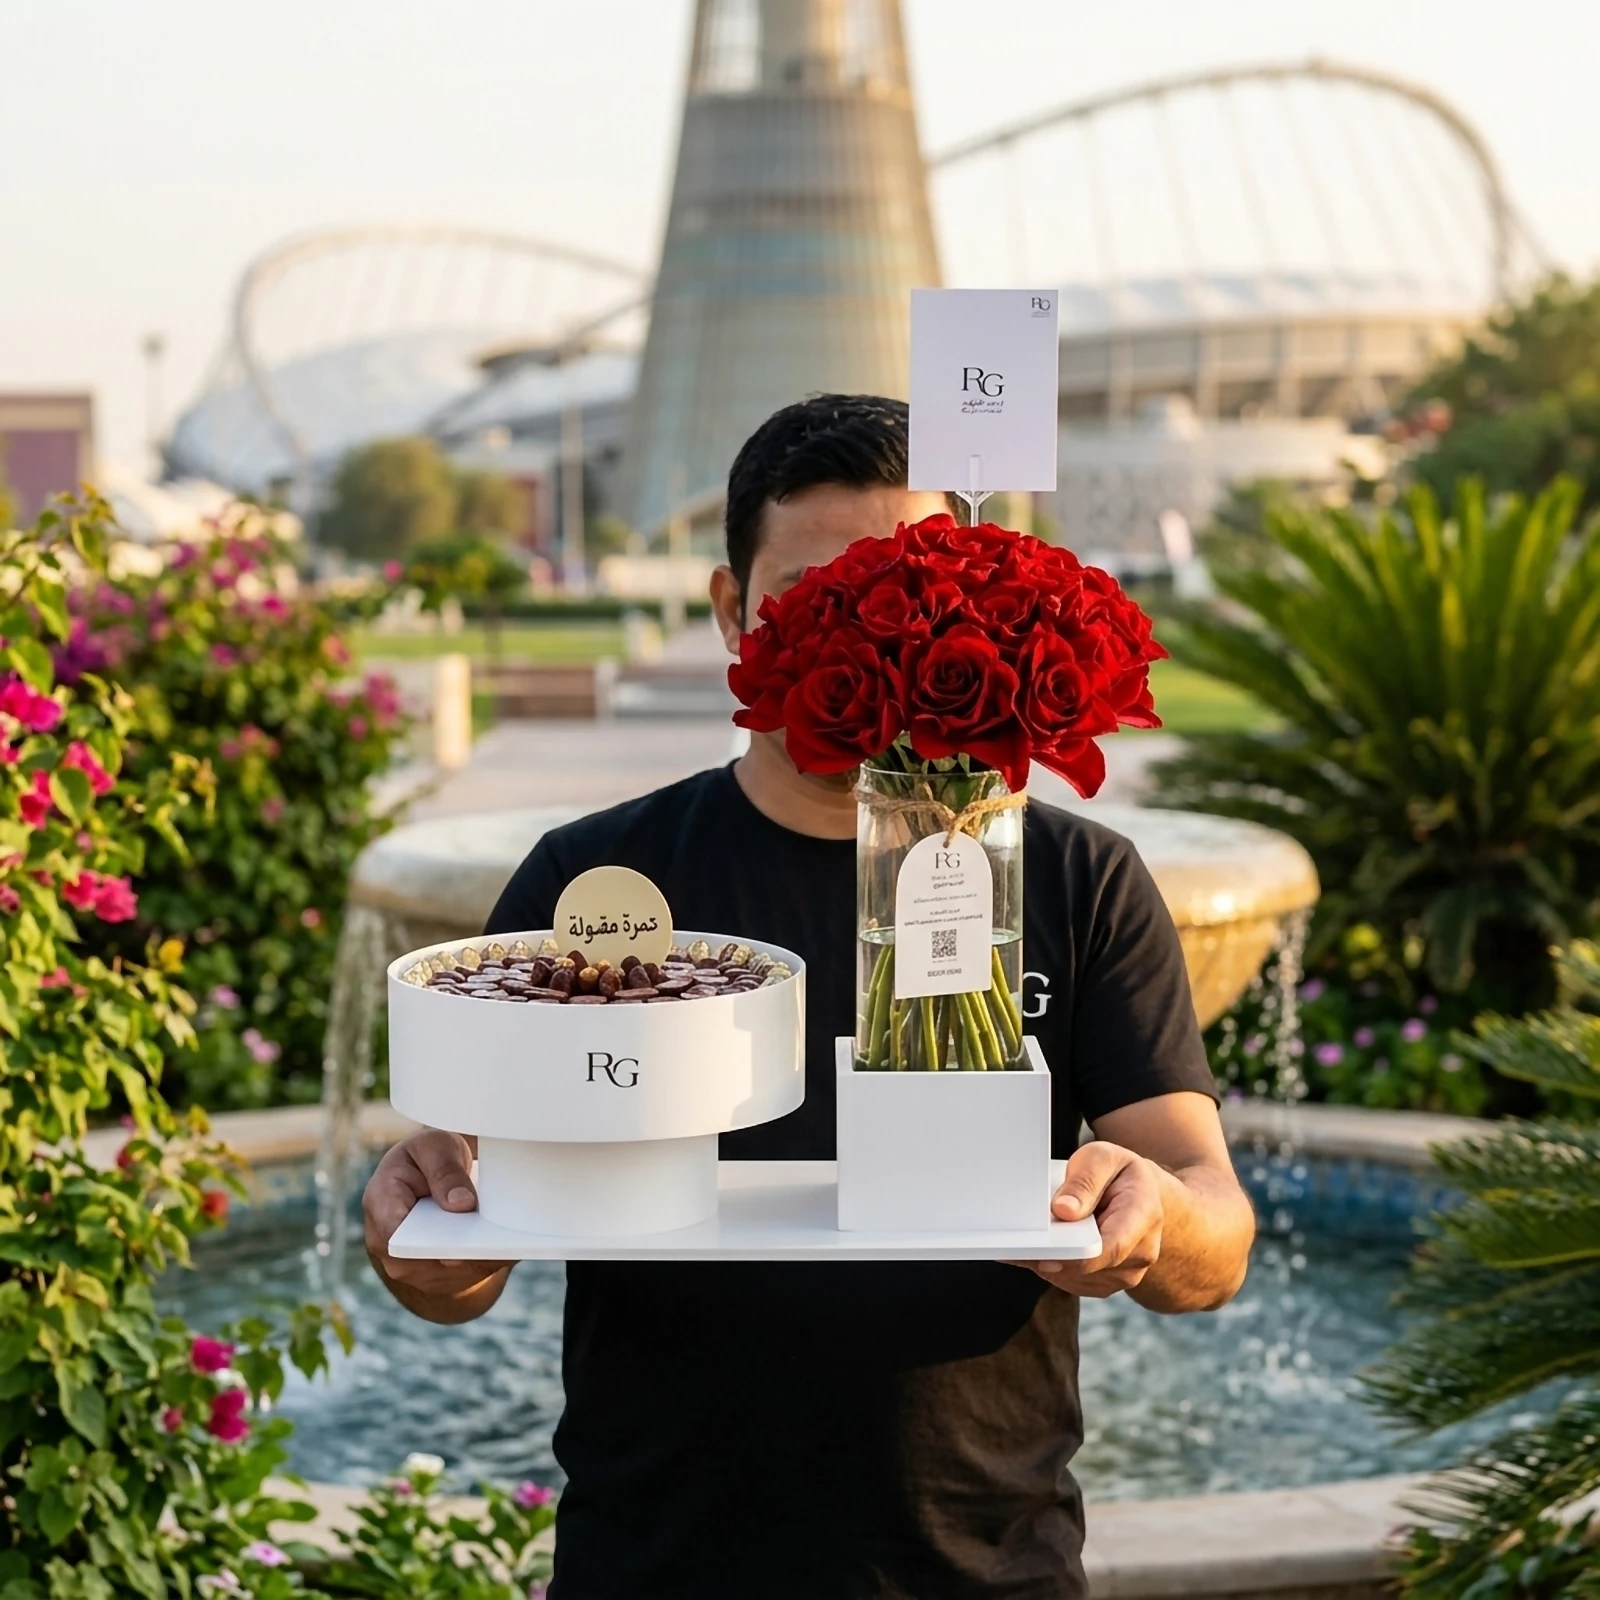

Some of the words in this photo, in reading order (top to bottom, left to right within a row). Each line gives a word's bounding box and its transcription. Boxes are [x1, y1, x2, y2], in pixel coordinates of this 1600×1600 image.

[961, 367, 1005, 397] RG
[935, 851, 961, 869] RG
[622, 913, 658, 941] تمرة
[586, 1052, 639, 1088] RG
